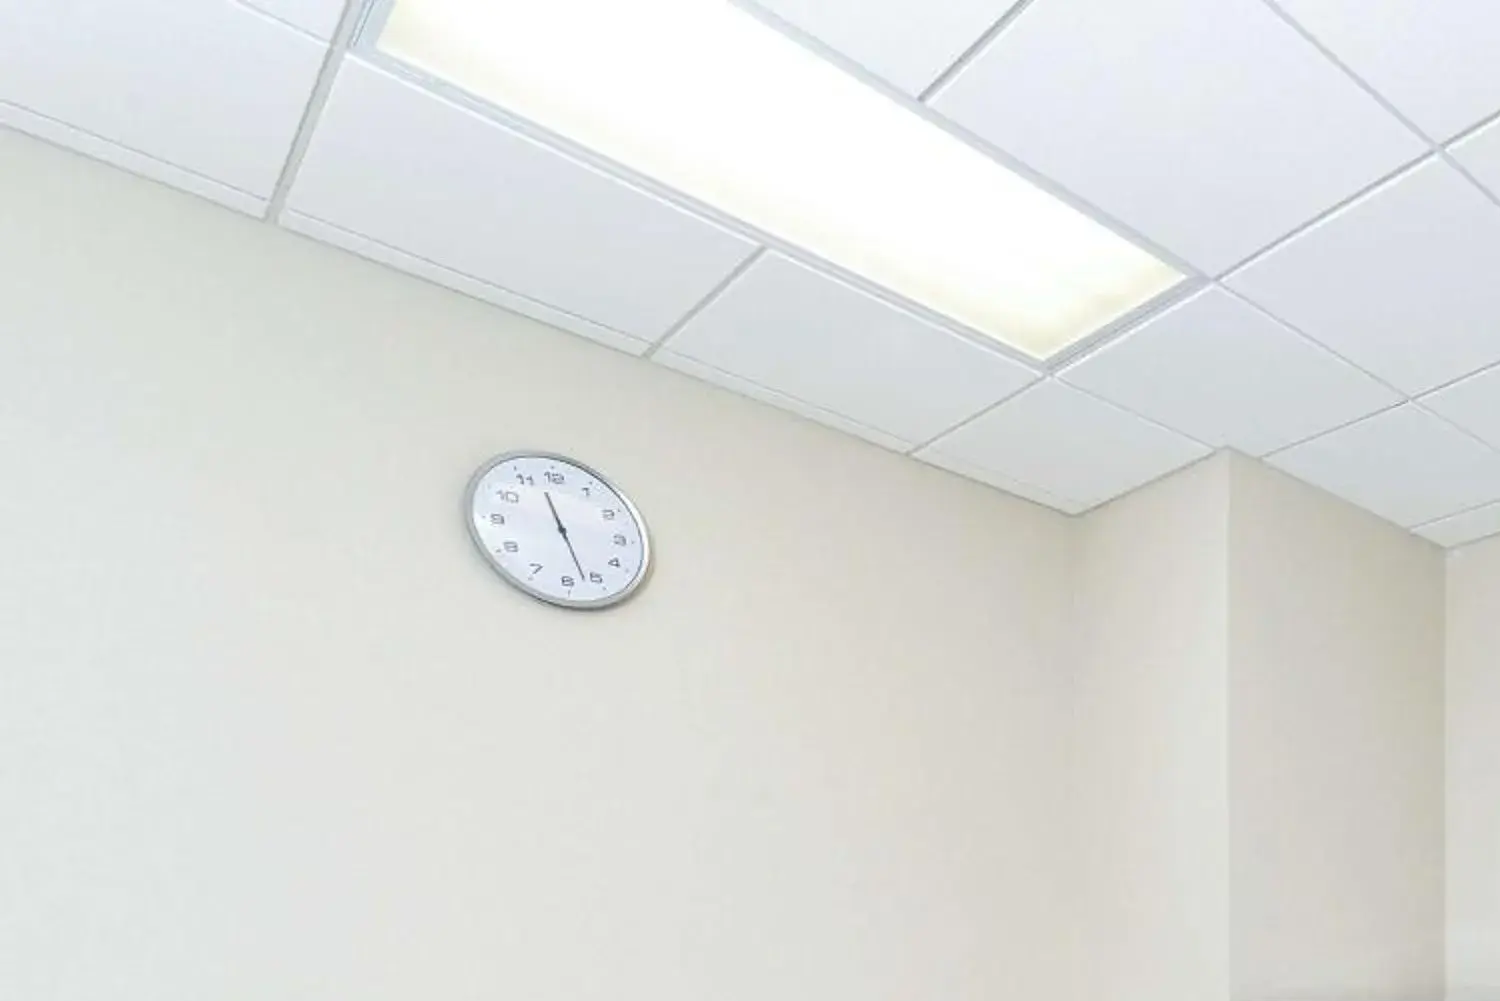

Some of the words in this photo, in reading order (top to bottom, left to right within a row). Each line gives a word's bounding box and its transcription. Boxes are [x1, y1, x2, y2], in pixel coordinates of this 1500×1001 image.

[516, 474, 534, 486] 11
[544, 471, 564, 485] 12
[496, 490, 520, 503] 10
[581, 487, 590, 497] 1
[490, 513, 505, 525] 9
[607, 557, 621, 568] 4
[529, 563, 544, 575] 7
